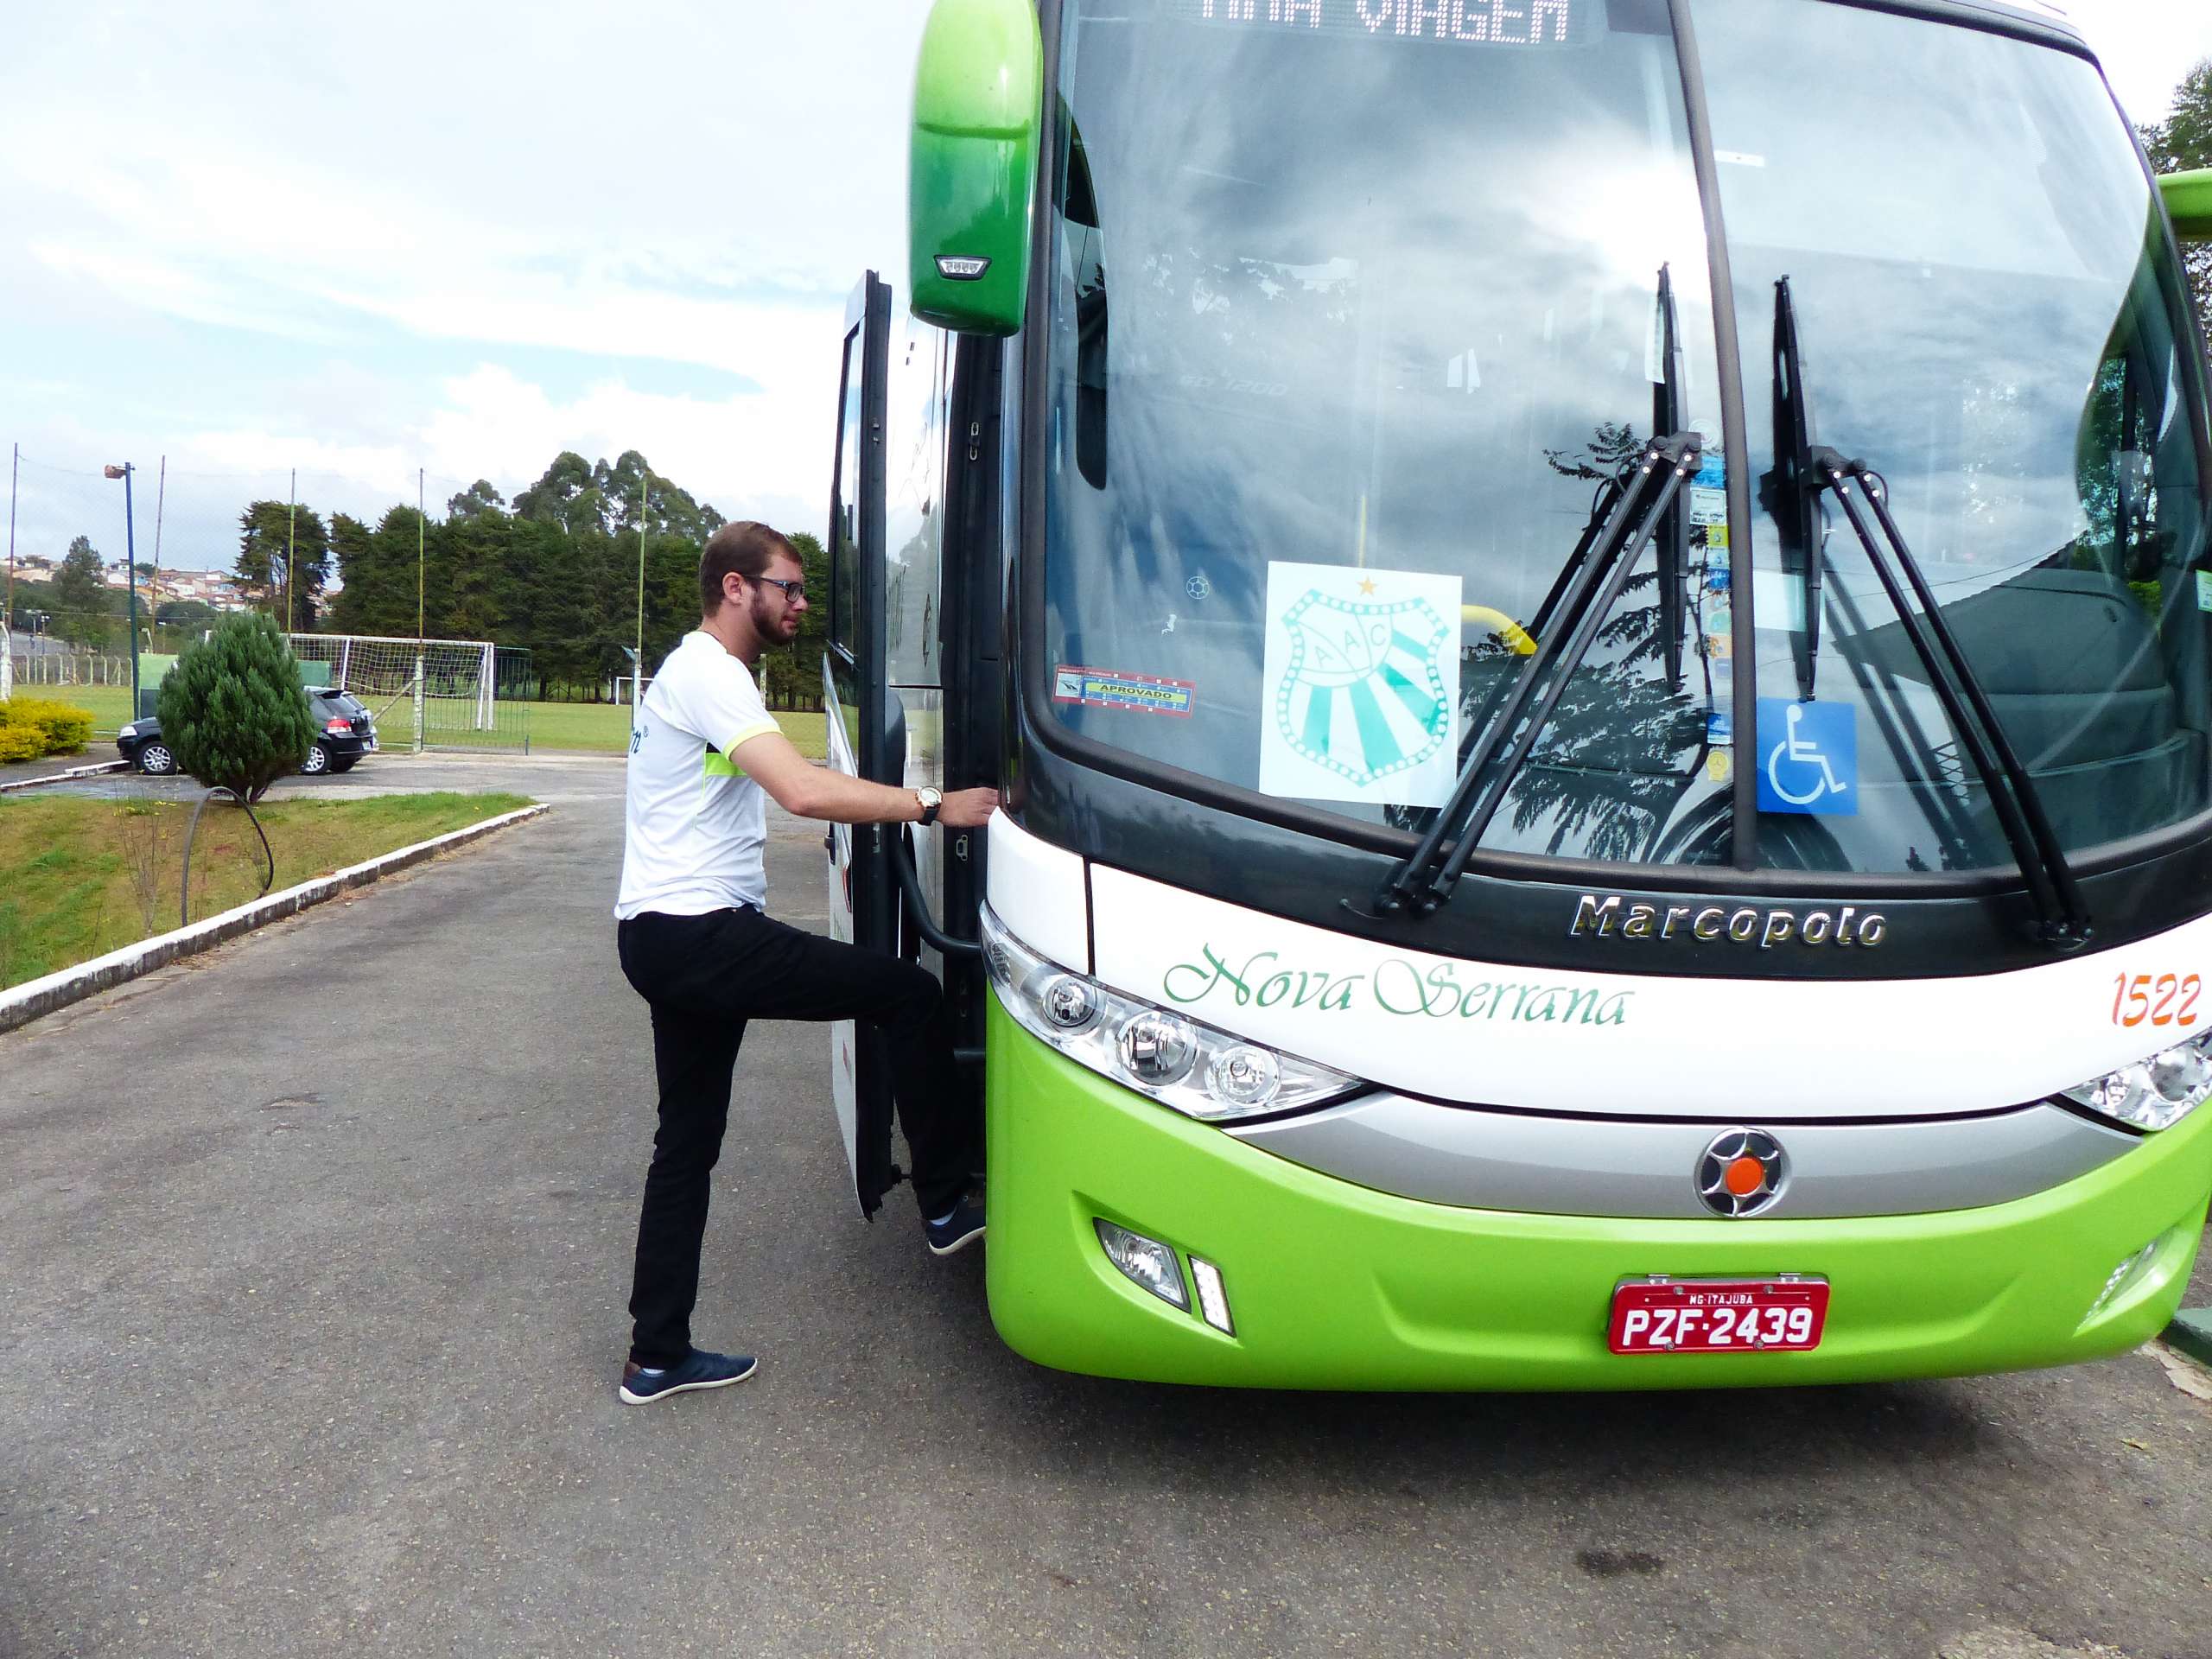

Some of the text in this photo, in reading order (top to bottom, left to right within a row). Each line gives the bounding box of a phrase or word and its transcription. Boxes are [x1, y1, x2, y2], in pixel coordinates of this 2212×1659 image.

[1356, 0, 1569, 43] VIAGEM
[1100, 683, 1173, 699] APROVADO
[1568, 895, 1888, 949] Marcopolo
[1164, 943, 1636, 1026] Nova Serrana
[2112, 971, 2202, 1027] 1522
